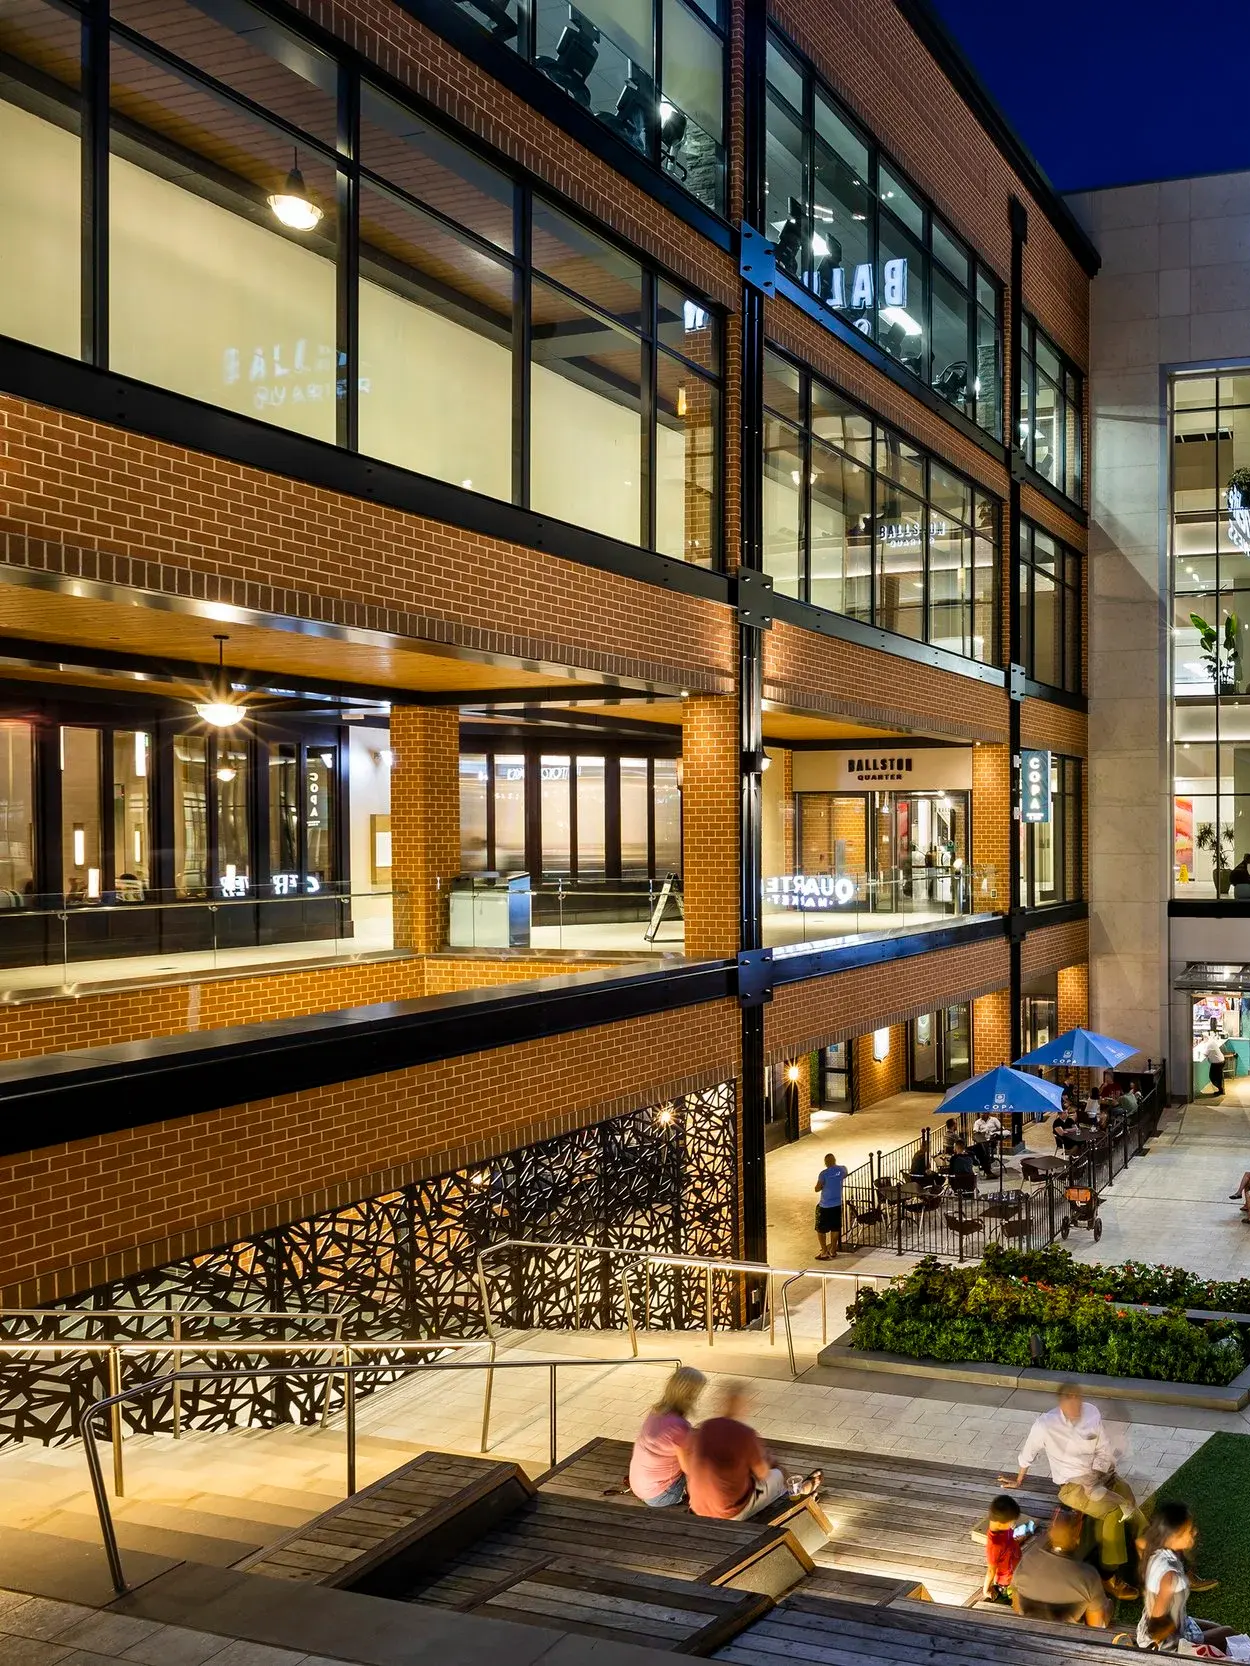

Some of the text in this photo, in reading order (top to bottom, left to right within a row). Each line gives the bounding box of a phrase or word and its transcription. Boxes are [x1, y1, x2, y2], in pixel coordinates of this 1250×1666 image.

[880, 520, 946, 540] BALLSON
[847, 757, 912, 773] BALLSTON
[857, 773, 902, 781] QUARTER
[1028, 756, 1041, 810] COPA
